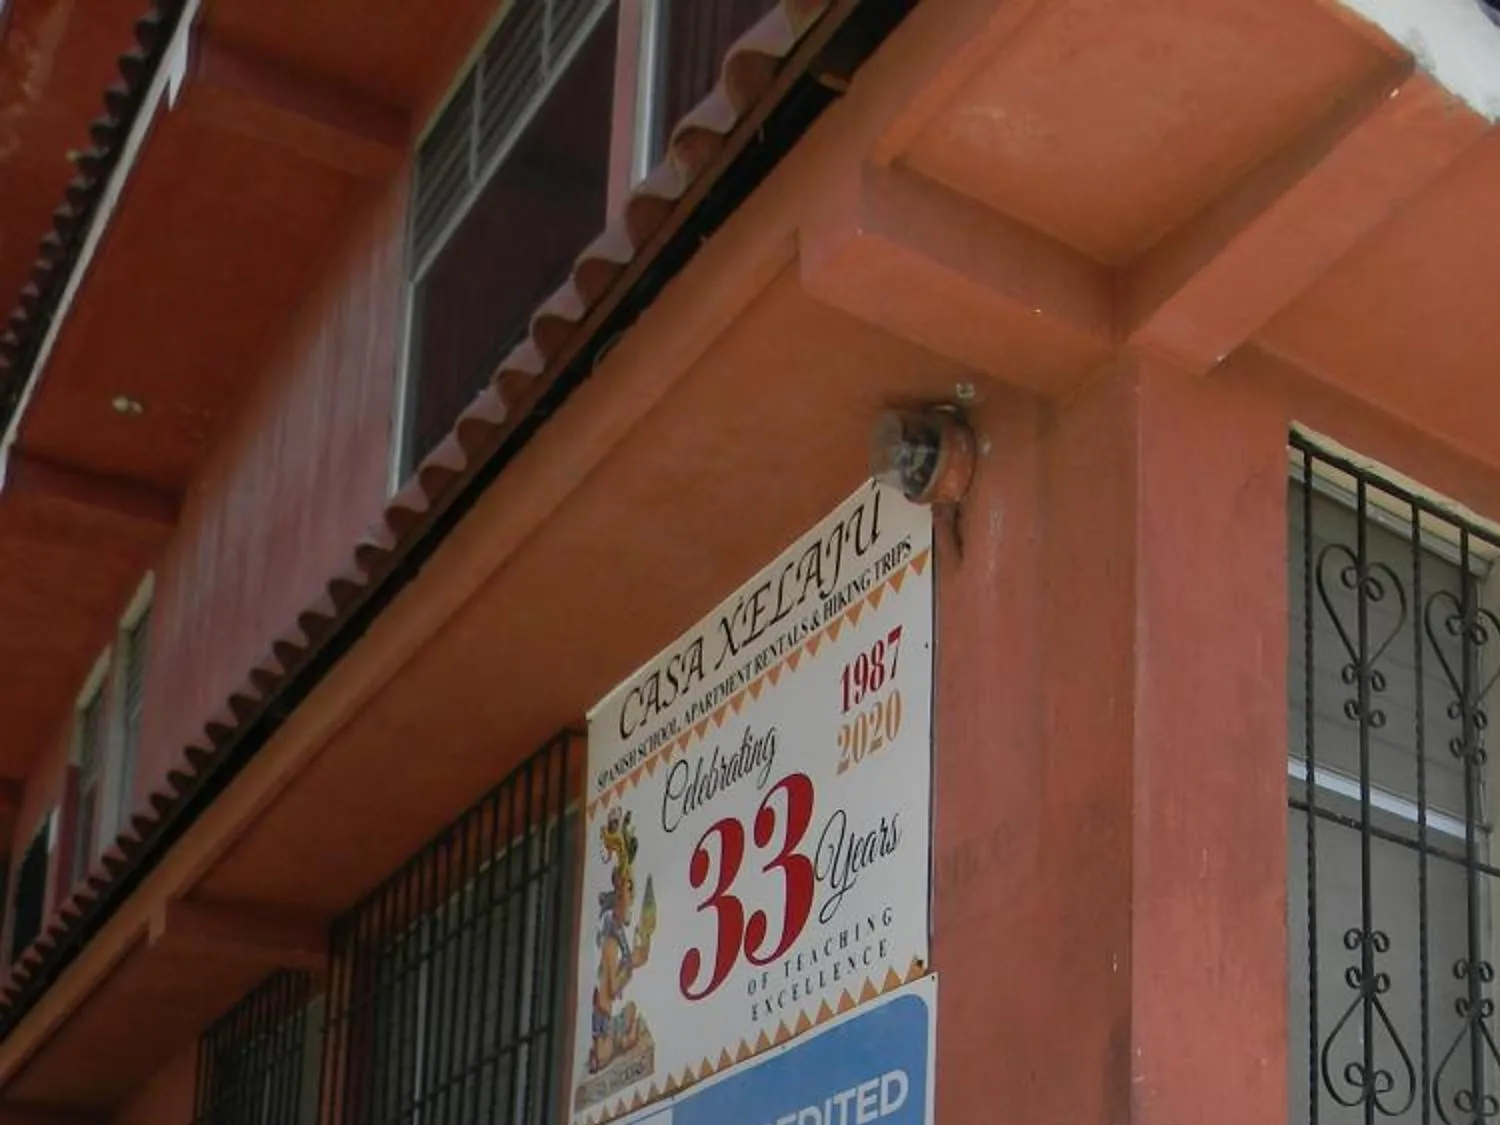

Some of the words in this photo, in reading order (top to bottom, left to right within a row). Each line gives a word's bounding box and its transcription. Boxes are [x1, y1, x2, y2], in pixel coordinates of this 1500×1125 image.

[684, 659, 754, 724] APARTMENT
[753, 620, 810, 677] RENTALS
[810, 609, 822, 632] &
[824, 567, 872, 623] HIKING
[874, 534, 912, 581] TRIPS
[839, 625, 903, 716] 1987
[620, 638, 704, 740] CASA
[836, 690, 901, 776] 2020
[662, 724, 777, 833] Celebrating
[679, 773, 815, 1000] 33
[815, 809, 902, 924] Years
[747, 967, 771, 996] OF
[783, 906, 894, 975] TEACHING
[751, 937, 890, 1022] EXCELLENCE
